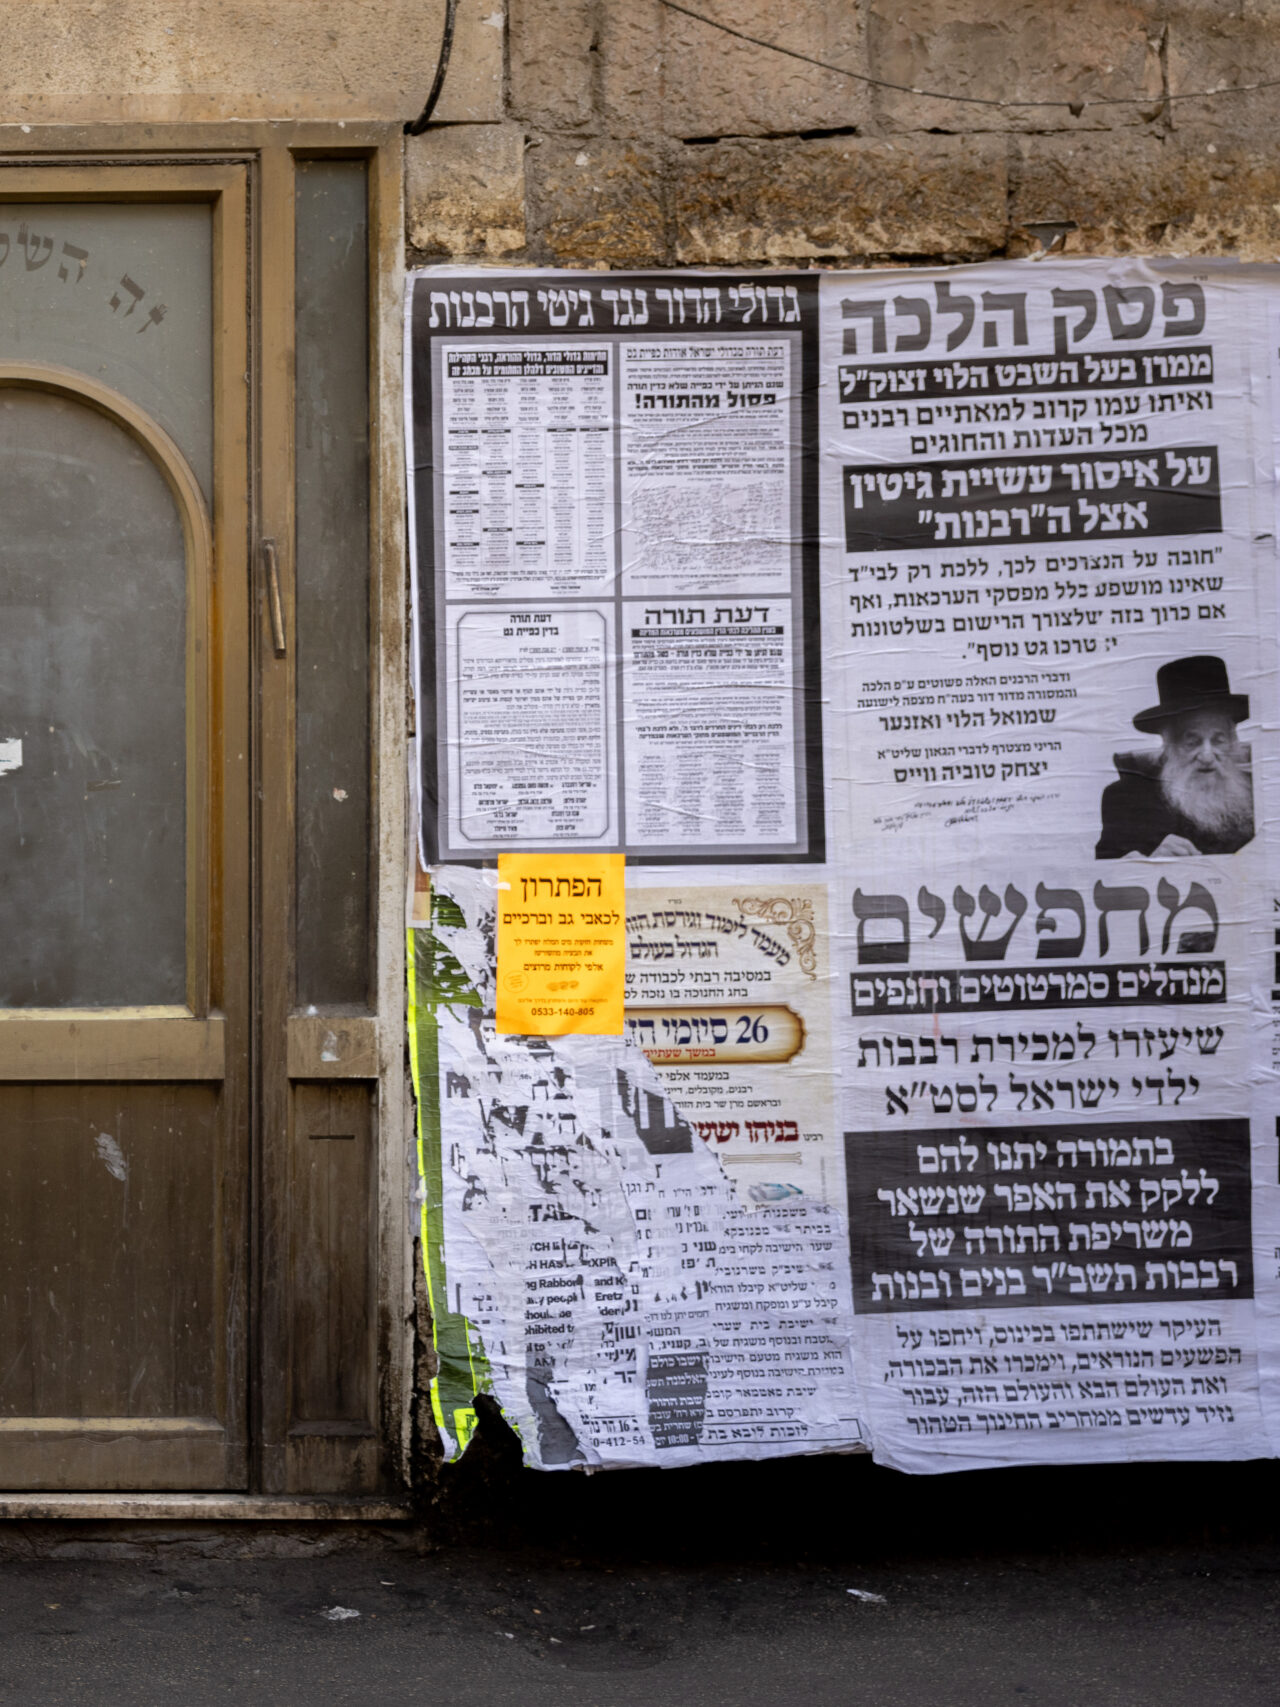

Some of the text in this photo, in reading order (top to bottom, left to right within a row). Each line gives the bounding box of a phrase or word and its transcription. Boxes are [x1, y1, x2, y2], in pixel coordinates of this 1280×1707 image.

[108, 273, 169, 334] זה
[428, 283, 801, 328] גדולי הדור נגד גיטי הרבנות
[840, 281, 1206, 355] פסק הלכה
[841, 353, 1211, 396] ממרן בעל השבט הלוי זצוק"ל
[635, 392, 776, 409] פסול מהתורה!
[842, 390, 1213, 429] ואיתו עמו קרוב למאתיים רבנים
[910, 422, 1147, 455] מכל העדות והחוגים
[849, 452, 1211, 509] על איסור עשיית גיטין
[918, 500, 1148, 540] אצל ה"רבנות"
[848, 547, 1222, 583] "חובה על הנצרכים לכך, ללכת רק לבי"ד
[510, 614, 552, 623] דעת תורה
[645, 606, 769, 625] דעת תורה
[879, 708, 1056, 731] שמואל הלוי ואזנער
[893, 761, 1048, 783] יצחק טוביה ווייס
[520, 877, 602, 902] הפתרון
[503, 913, 619, 925] לכאבי גב וברכיים
[853, 877, 1219, 964] מחפשים
[629, 941, 718, 960] הגדול בעולם
[640, 970, 771, 983] במסיבה רבתי לכבודה
[641, 988, 748, 999] בחג החנוכה בו נזכה
[853, 965, 1223, 1006] מנהלים סמרטוטים וחנפים
[531, 1007, 594, 1016] 0533-140-805
[661, 1015, 768, 1045] 26 סיומי
[857, 1022, 1224, 1067] שיעזרו למכירת רבבות
[885, 1067, 1200, 1115] ילדי ישראל לסט"א
[744, 1119, 799, 1142] בניהו
[917, 1136, 1174, 1173] בתמורה יתנו להם
[877, 1168, 1219, 1216] ללקק את האפר שנשאר
[908, 1218, 1192, 1257] משריפת התורה של
[594, 1277, 613, 1287] and
[595, 1292, 623, 1301] Eretz
[871, 1258, 1238, 1301] רבבות תשב"ר בנים ובנות
